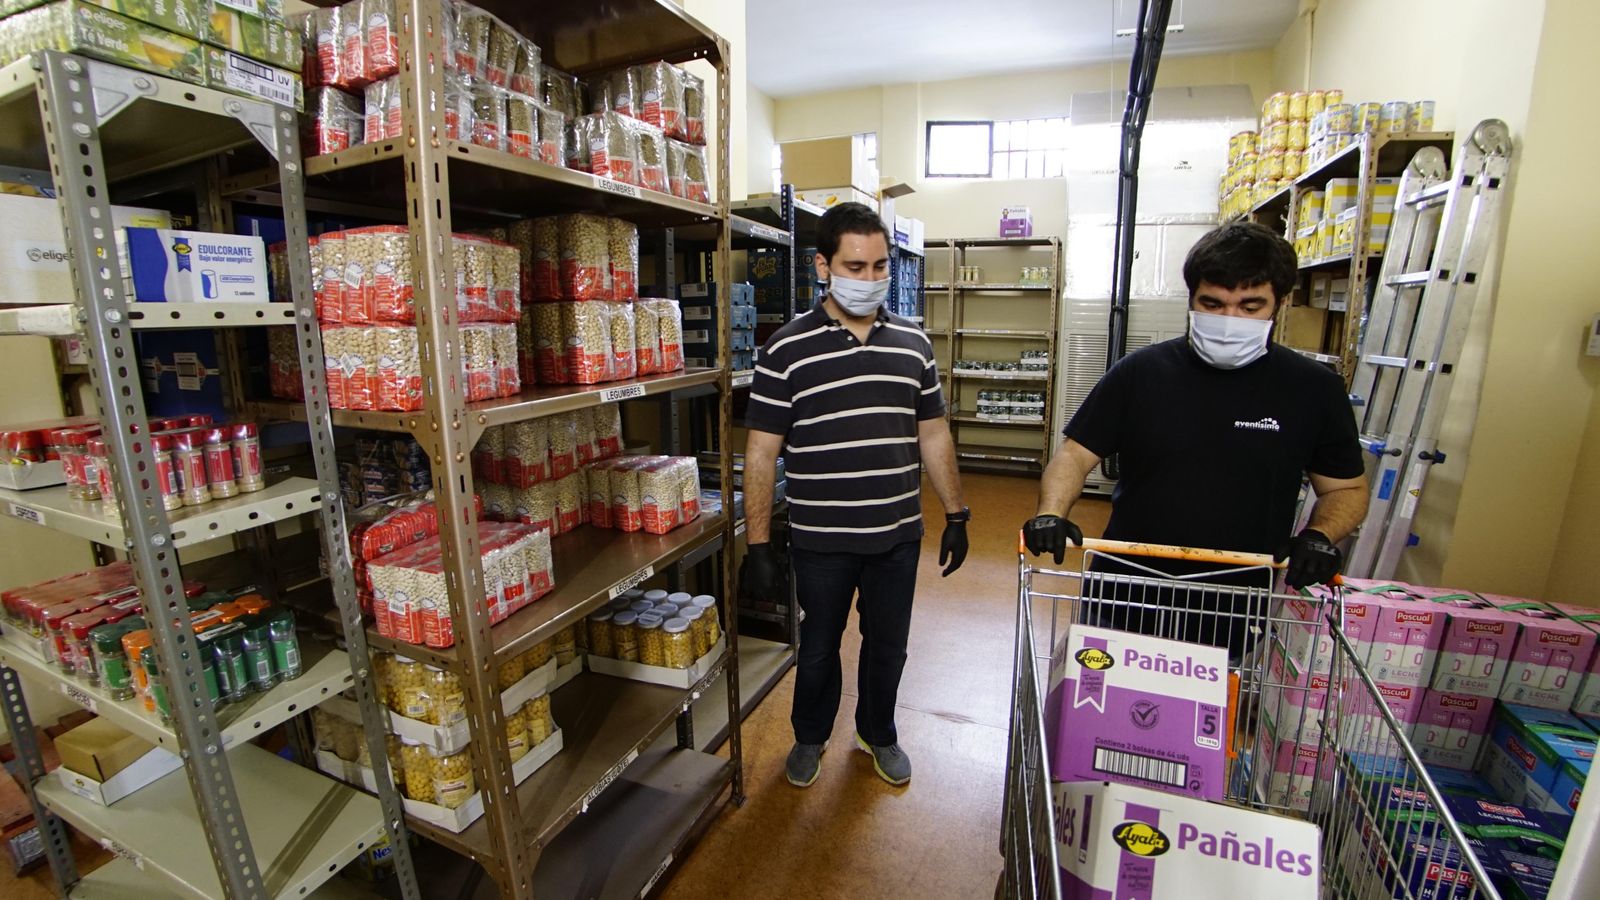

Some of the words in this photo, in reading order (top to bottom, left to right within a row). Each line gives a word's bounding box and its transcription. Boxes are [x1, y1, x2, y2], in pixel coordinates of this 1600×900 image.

[93, 12, 127, 31] eliges
[80, 26, 95, 41] Té
[97, 33, 129, 53] Verde
[277, 74, 290, 86] UV
[598, 179, 636, 197] LEGUMBRES
[198, 244, 252, 256] EDULCORANTE
[606, 386, 642, 401] LEGUMBRES
[615, 569, 648, 595] LEGUMBRES
[1344, 606, 1365, 615] cual
[1397, 612, 1431, 622] Pascual
[1467, 622, 1502, 632] Pascual
[1541, 631, 1578, 643] Pascual
[1123, 648, 1219, 682] Pañales
[1392, 669, 1420, 678] LECHE
[1460, 679, 1490, 689] LECHE
[1441, 696, 1476, 707] Pascual
[1201, 704, 1219, 714] TALLA
[1202, 714, 1216, 735] 5
[1094, 736, 1125, 749] Contiene
[1126, 741, 1131, 750] 2
[1132, 743, 1156, 755] bolsas
[1156, 747, 1166, 756] de
[1166, 749, 1177, 758] 44
[1176, 750, 1190, 761] uds
[1053, 792, 1076, 848] ales
[1506, 816, 1541, 828] ENTERA
[1117, 825, 1165, 849] Ayala
[1177, 822, 1313, 877] Pañales
